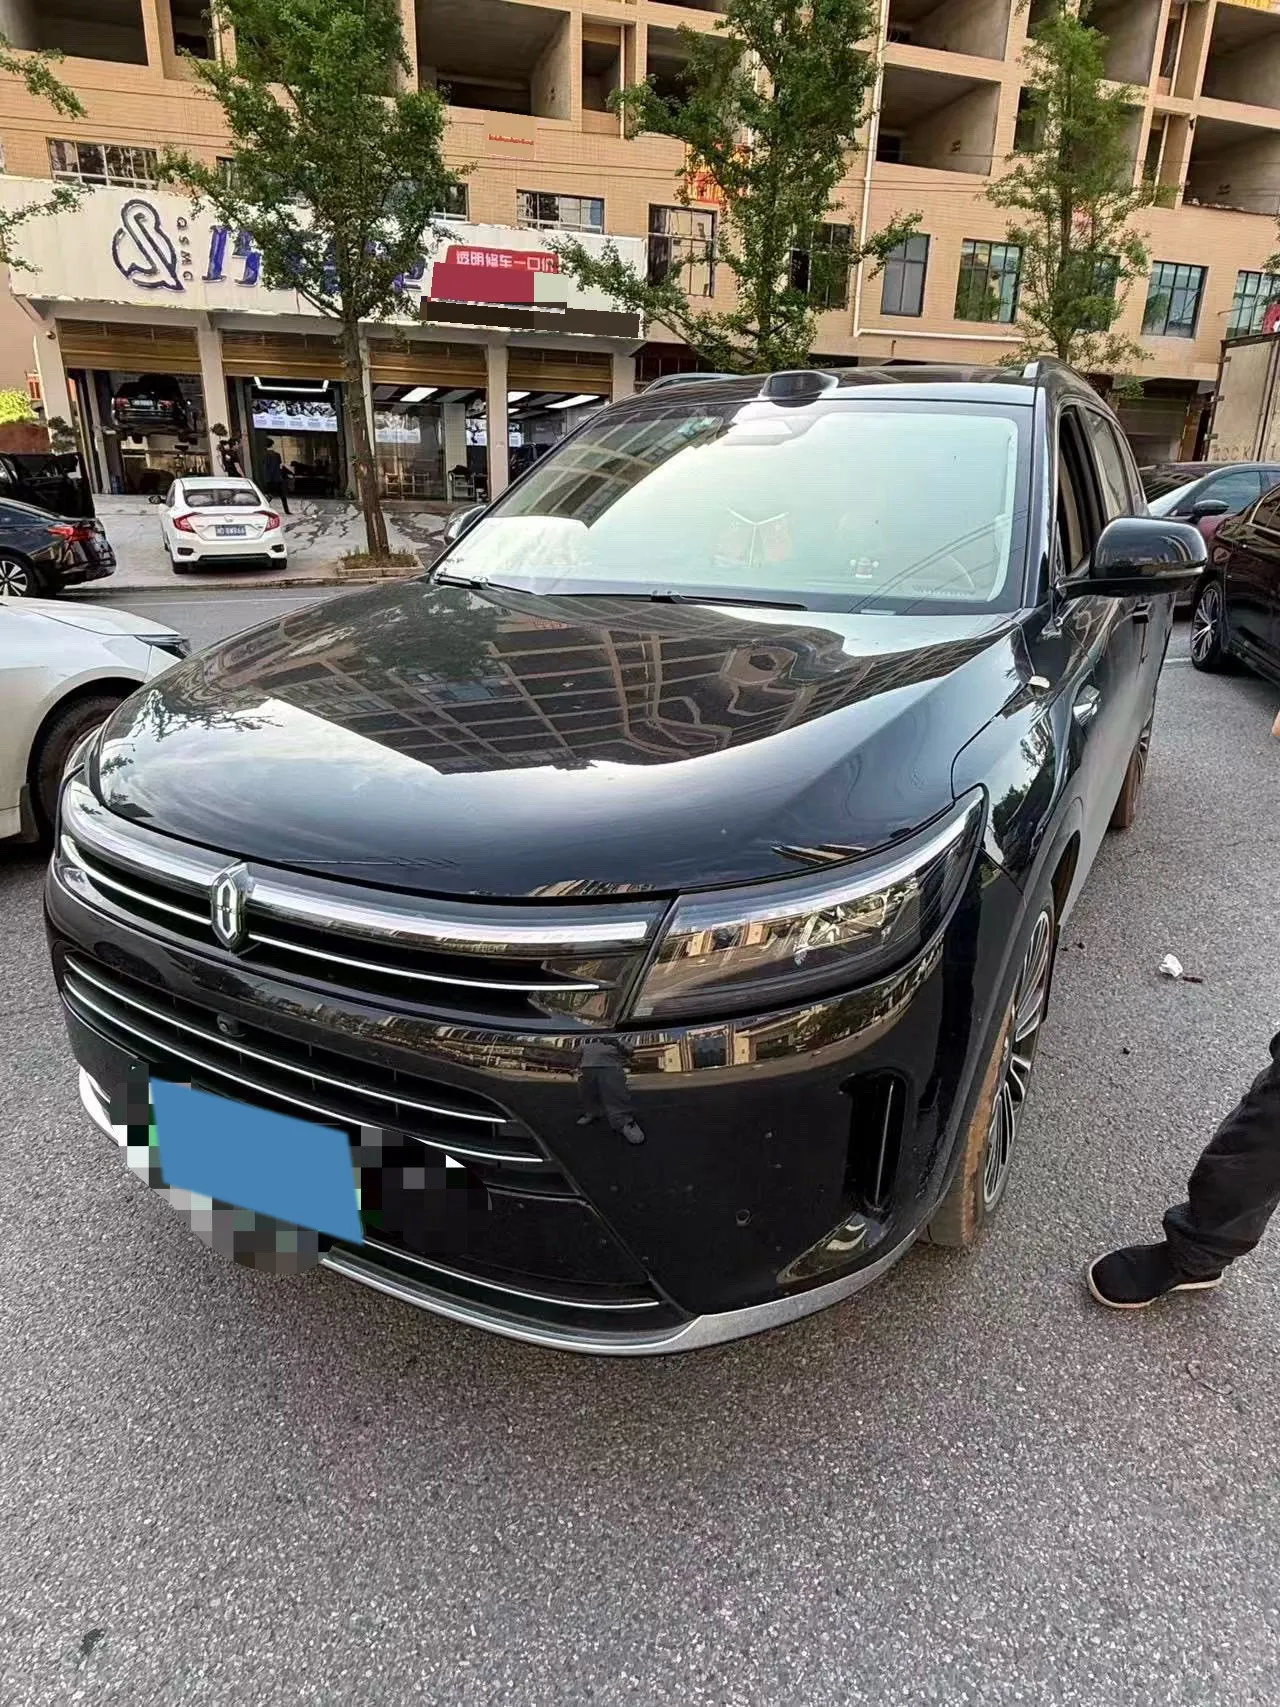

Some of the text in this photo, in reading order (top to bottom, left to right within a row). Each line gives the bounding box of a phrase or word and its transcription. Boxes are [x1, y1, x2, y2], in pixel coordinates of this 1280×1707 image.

[456, 250, 554, 272] 透明修车一口价
